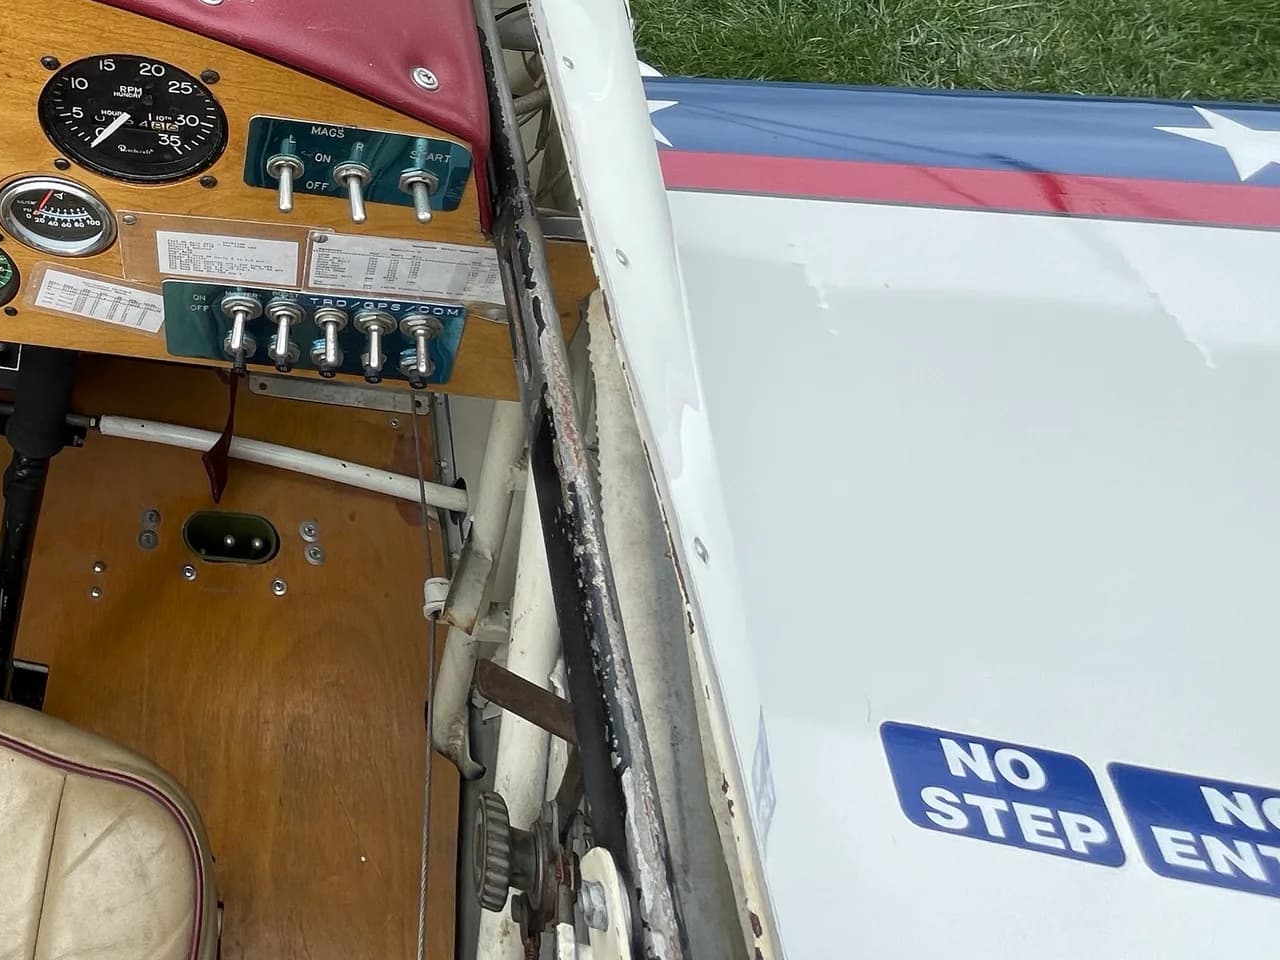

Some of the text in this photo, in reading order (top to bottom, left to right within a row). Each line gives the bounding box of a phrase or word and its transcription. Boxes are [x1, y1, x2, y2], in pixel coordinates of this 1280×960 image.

[99, 59, 166, 77] 15 20
[71, 77, 193, 96] 10 RPM 25
[72, 107, 84, 118] 5
[175, 115, 200, 127] 30
[311, 126, 345, 139] MAGS
[158, 134, 182, 147] 35
[290, 134, 364, 152] L R
[315, 151, 452, 164] ON START
[306, 181, 329, 191] OFF
[193, 294, 206, 302] ON
[191, 305, 210, 313] OFF
[939, 738, 1046, 791] NO
[920, 785, 1108, 855] STEP
